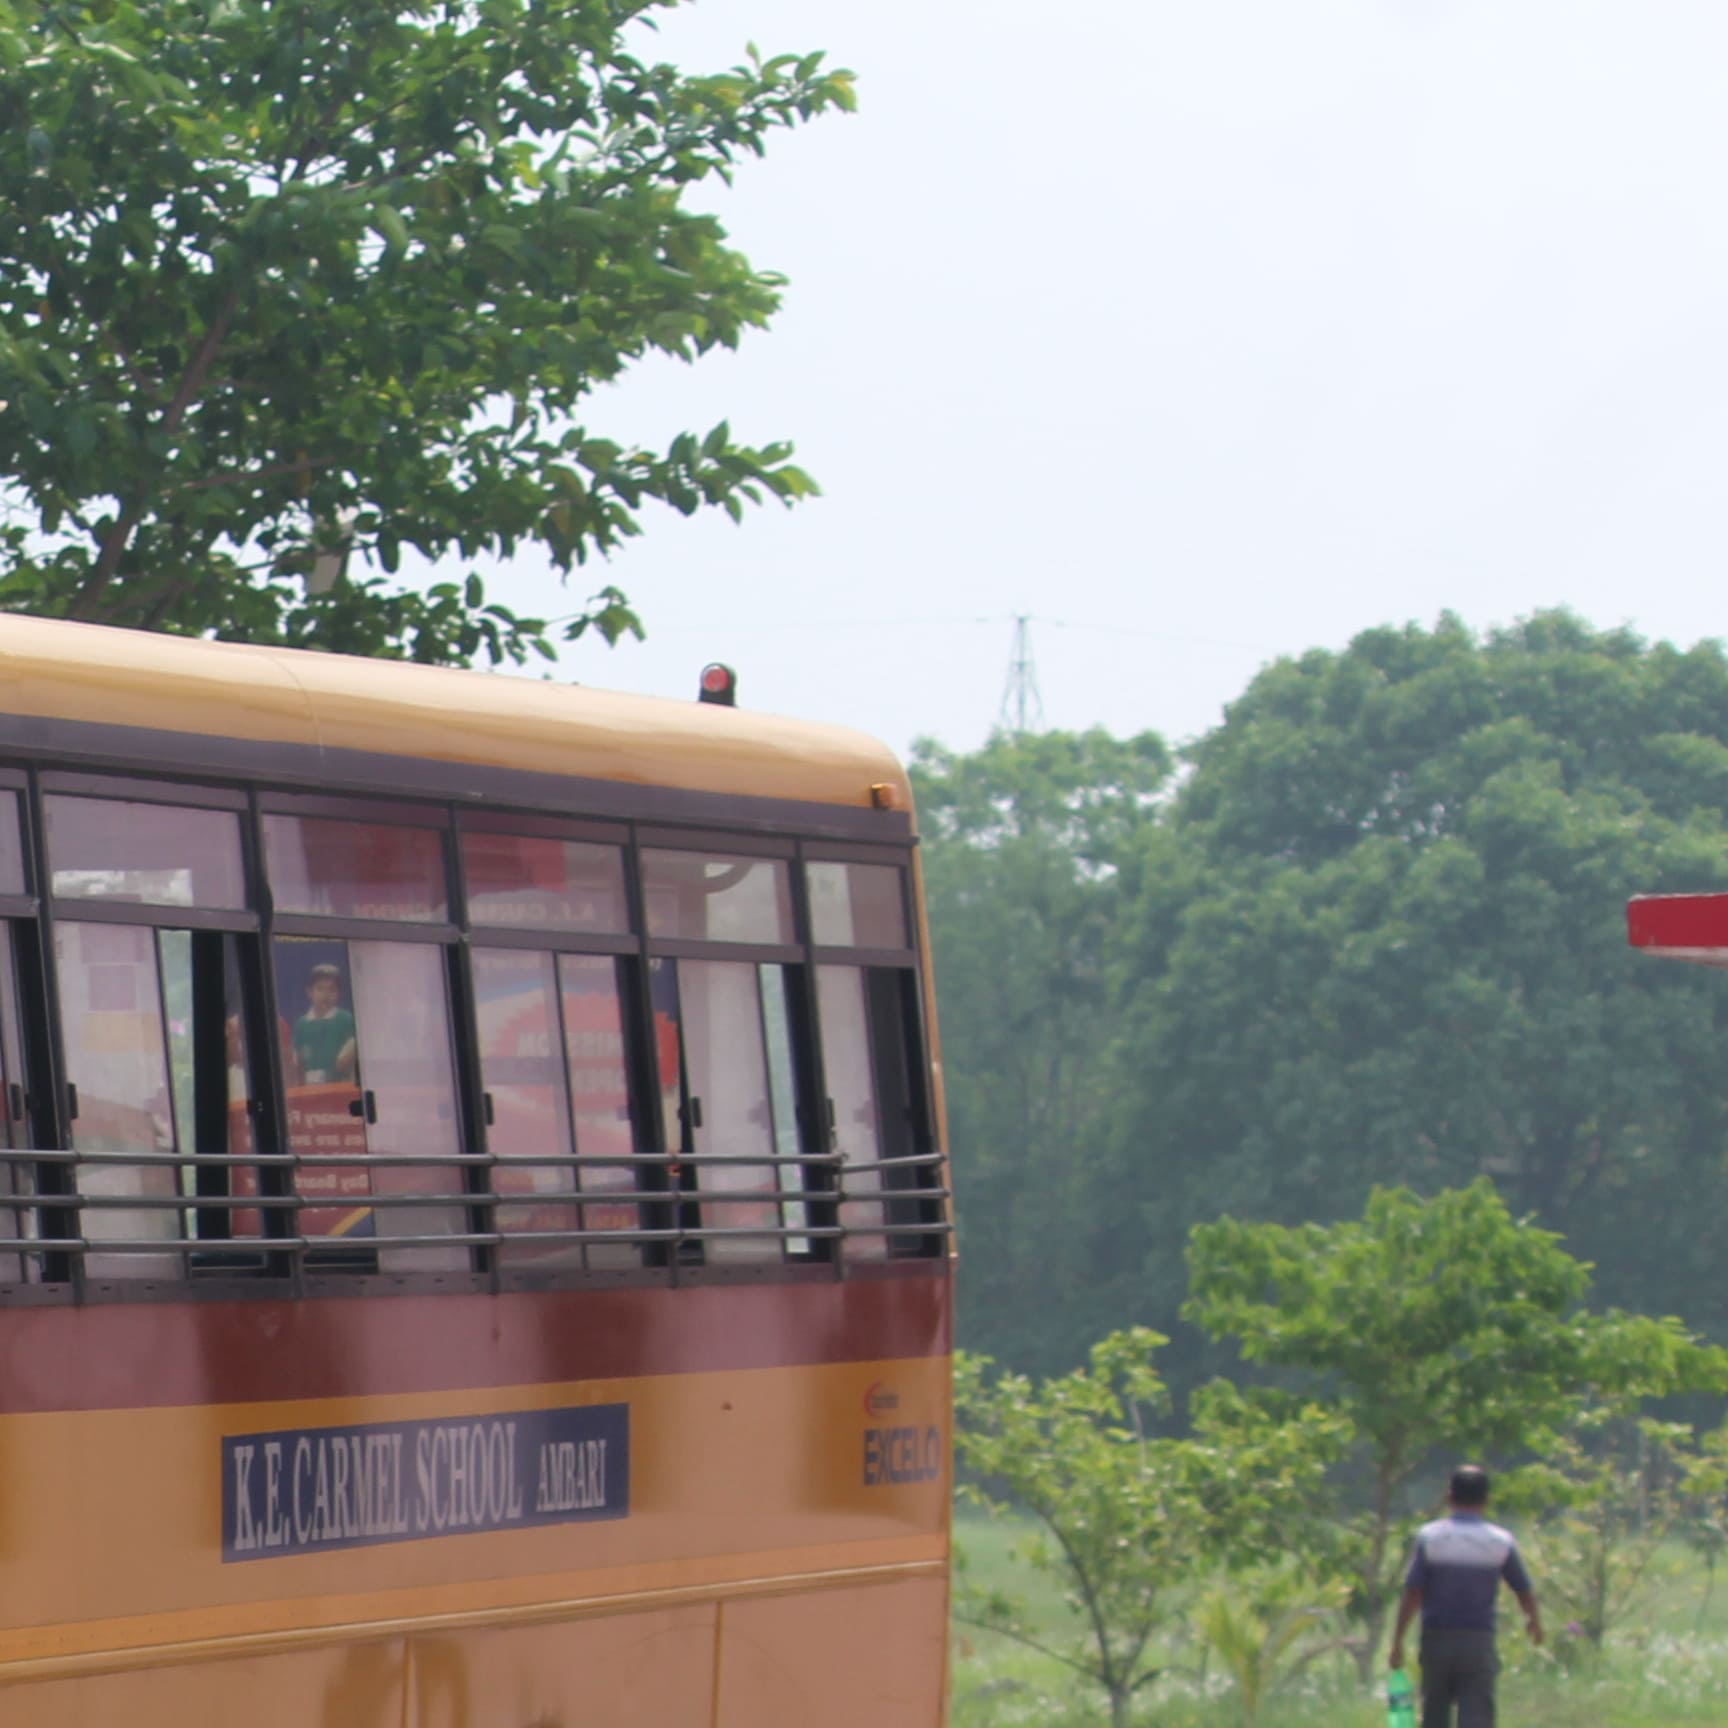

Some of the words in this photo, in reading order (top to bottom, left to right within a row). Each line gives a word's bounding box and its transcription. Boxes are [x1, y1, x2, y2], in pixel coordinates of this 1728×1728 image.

[415, 1422, 523, 1532] SCHOOL
[536, 1439, 608, 1513] AMBARI
[863, 1425, 941, 1486] EXCELO
